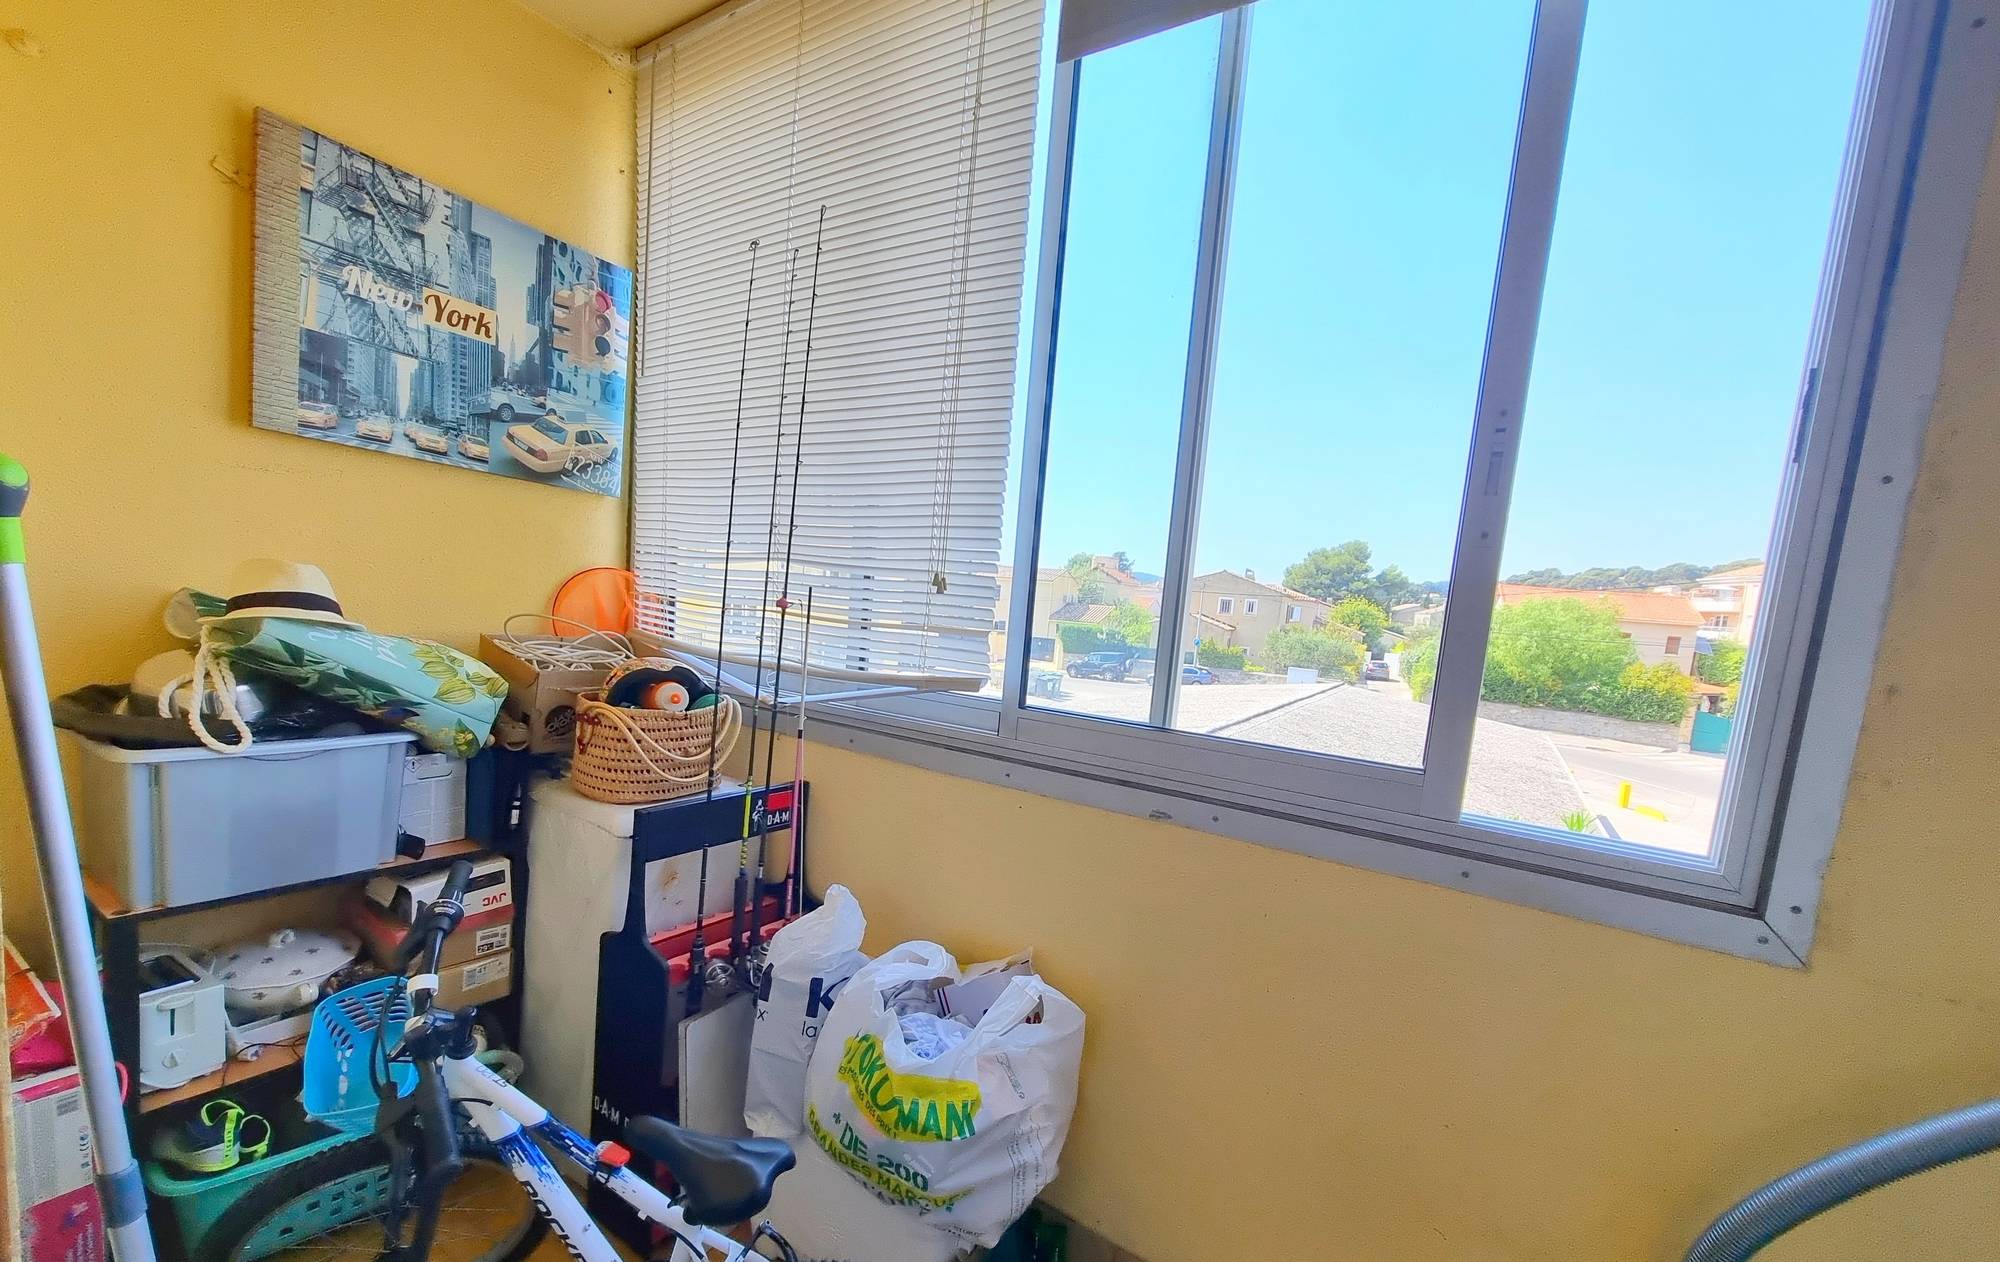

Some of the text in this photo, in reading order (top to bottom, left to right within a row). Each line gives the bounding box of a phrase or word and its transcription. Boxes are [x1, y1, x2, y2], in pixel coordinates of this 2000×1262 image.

[342, 265, 493, 339] New York
[482, 892, 507, 907] JVC
[840, 1121, 869, 1162] DE
[876, 1154, 929, 1193] 200
